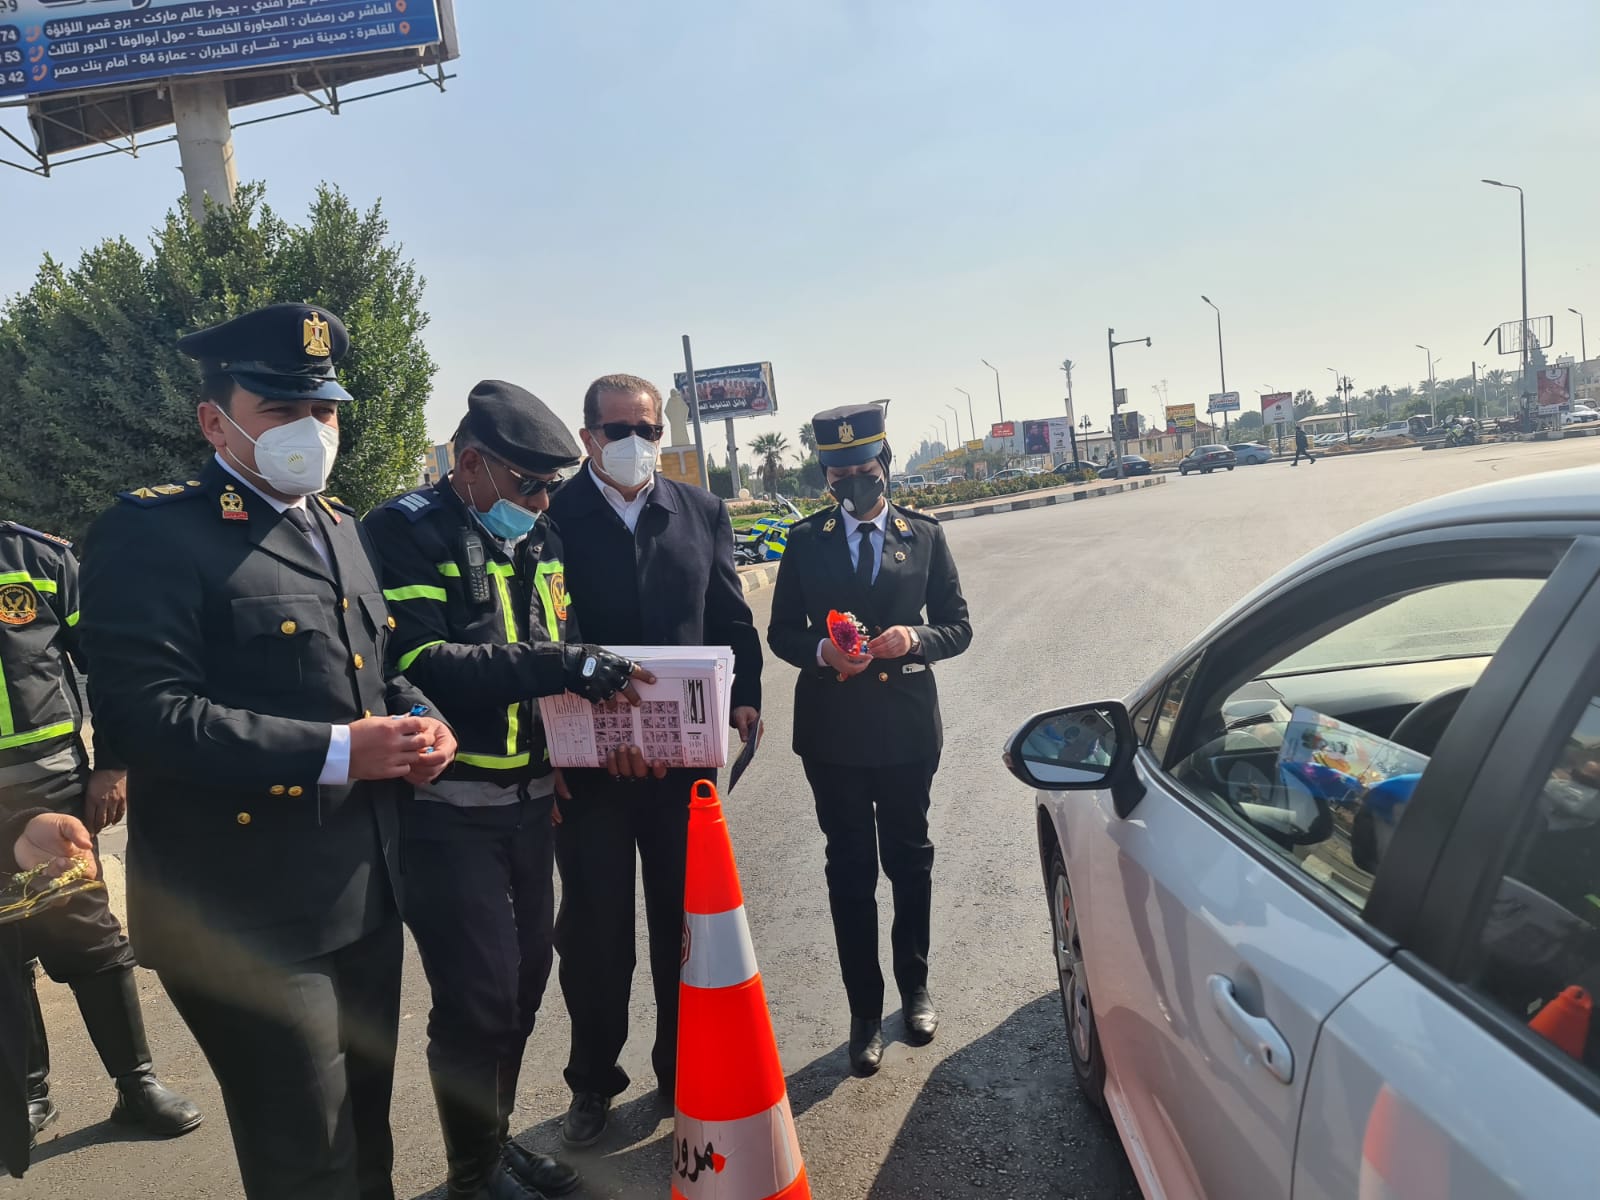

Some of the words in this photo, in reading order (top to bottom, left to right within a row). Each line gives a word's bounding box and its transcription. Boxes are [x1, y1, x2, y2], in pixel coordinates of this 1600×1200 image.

[181, 8, 205, 21] عالم
[338, 10, 355, 22] من
[359, 3, 392, 17] العاشر
[114, 17, 131, 30] برج
[143, 10, 177, 25] ماركت
[244, 16, 288, 33] المجاورة
[298, 13, 335, 27] رمضان
[86, 18, 111, 33] قصر
[197, 21, 241, 38] الخامسة
[356, 22, 396, 40] القاهرة
[162, 31, 186, 45] مول
[293, 34, 314, 49] نصر
[316, 32, 347, 45] مدينة
[48, 42, 80, 57] الثالث
[83, 38, 108, 54] الدور
[199, 42, 238, 59] الطيران
[4, 50, 21, 62] 53
[140, 53, 155, 65] 84
[158, 50, 188, 64] عمارة
[53, 65, 78, 78] مصر
[80, 59, 102, 73] بنك
[8, 71, 24, 83] 42
